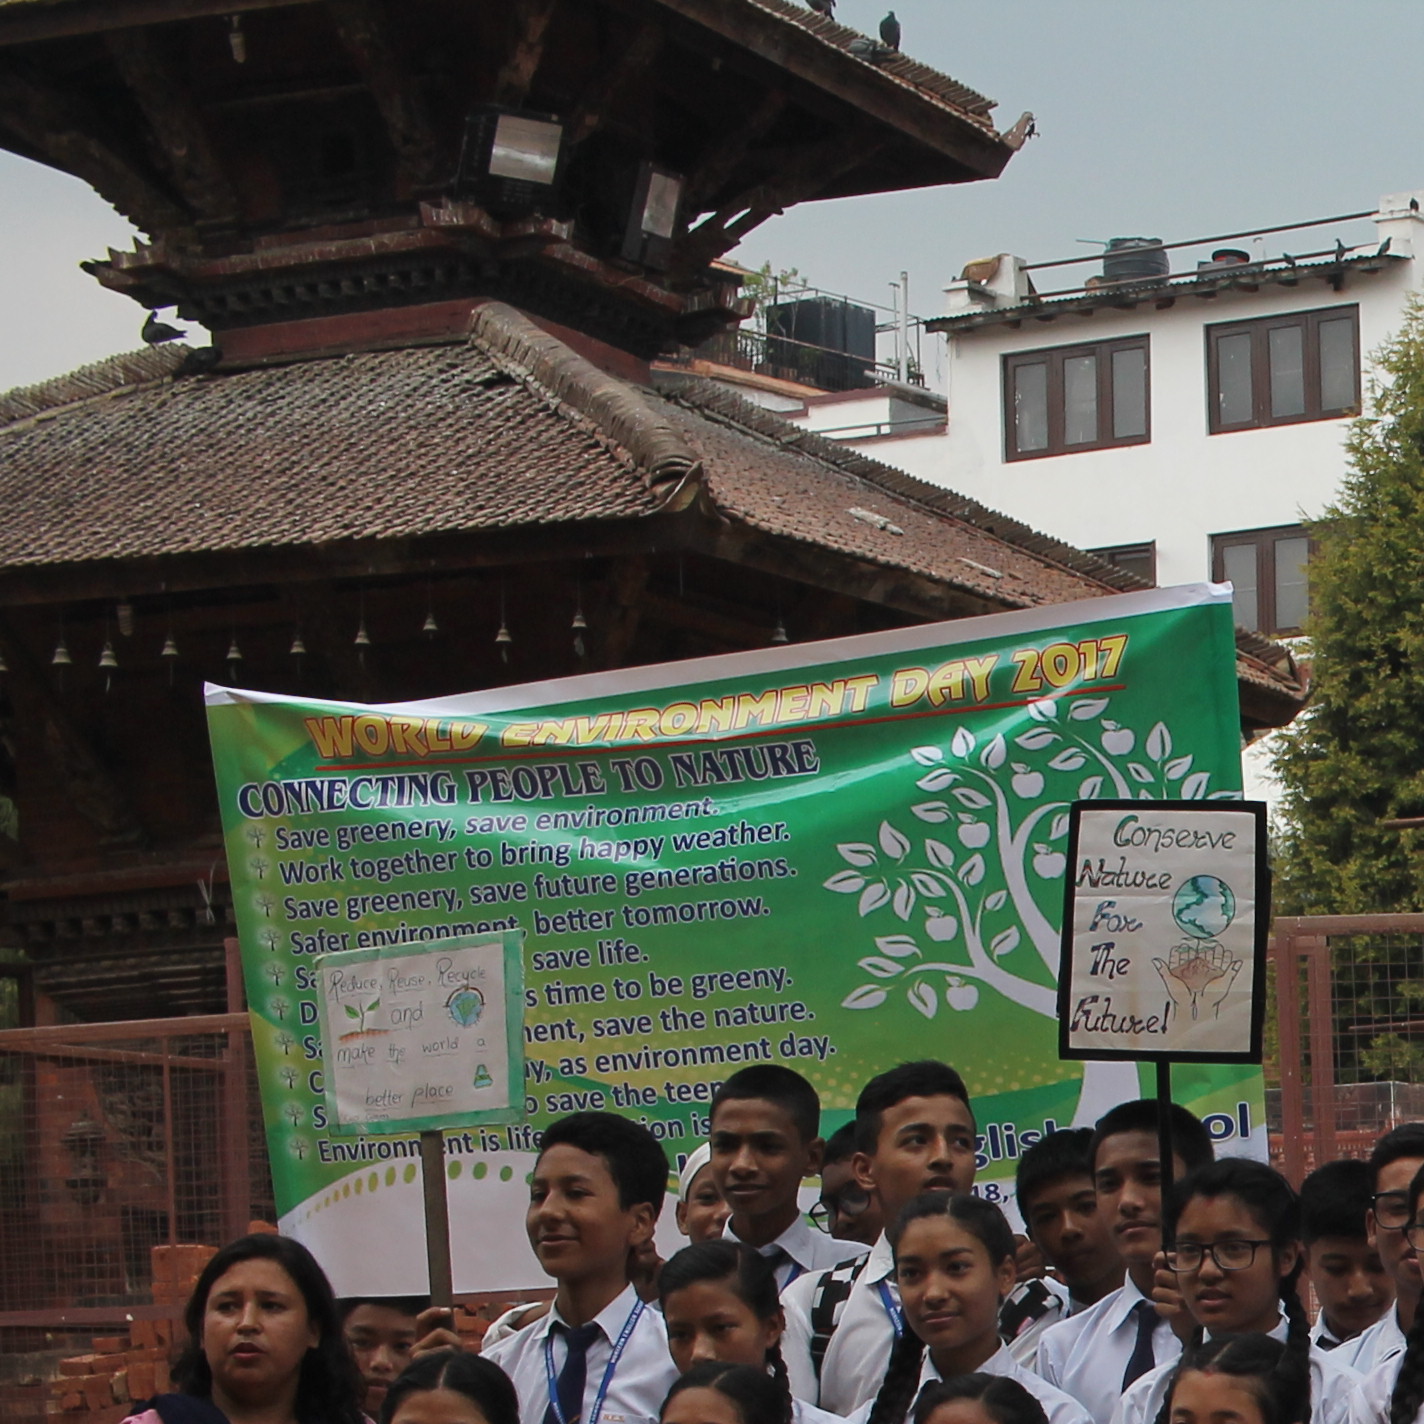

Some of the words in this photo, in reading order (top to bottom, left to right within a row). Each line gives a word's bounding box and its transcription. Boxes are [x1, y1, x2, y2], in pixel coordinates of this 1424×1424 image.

[304, 713, 489, 758] WORLD
[502, 675, 878, 747] ENVIRONMENT
[891, 654, 999, 708] DAY
[1012, 635, 1128, 693] 2017
[237, 770, 459, 820] CONNECTING
[466, 761, 606, 804] PEOPLE
[611, 757, 664, 791] TO
[668, 741, 820, 788] NATURE
[276, 826, 330, 850] Save
[337, 819, 456, 850] greenery,
[465, 813, 526, 834] save
[536, 797, 719, 831] environment.
[1114, 814, 1236, 852] Conserve
[279, 856, 344, 885] Work
[349, 848, 457, 882] together
[465, 847, 492, 869] to
[501, 840, 570, 866] bring
[579, 836, 664, 861] happy
[672, 821, 790, 851] weather.
[284, 897, 338, 920] Save
[346, 886, 462, 920] greenery,
[469, 882, 527, 904] save
[534, 872, 616, 899] future
[624, 857, 797, 896] generations.
[1075, 857, 1172, 889] Nature
[290, 929, 350, 954] Safer
[534, 909, 615, 935] better
[622, 897, 770, 925] tomorrow.
[1089, 900, 1143, 932] For
[436, 957, 486, 987] Recycle
[532, 949, 590, 971] save
[597, 939, 648, 965] life.
[1090, 941, 1130, 979] The
[545, 980, 605, 1006] time
[613, 977, 642, 1000] to
[649, 972, 683, 998] be
[692, 968, 793, 999] greeny.
[390, 1001, 424, 1027] and
[593, 1014, 652, 1038] save
[660, 1006, 705, 1032] the
[714, 1001, 814, 1027] nature.
[1070, 995, 1171, 1034] Future!
[337, 1043, 375, 1065] make
[422, 1036, 458, 1053] world
[477, 1039, 486, 1048] a
[559, 1056, 588, 1076] as
[595, 1039, 771, 1073] environment
[778, 1032, 836, 1061] day.
[365, 1088, 403, 1107] better
[411, 1083, 453, 1109] place
[546, 1090, 604, 1114] save
[612, 1077, 657, 1106] the
[479, 1130, 500, 1153] is
